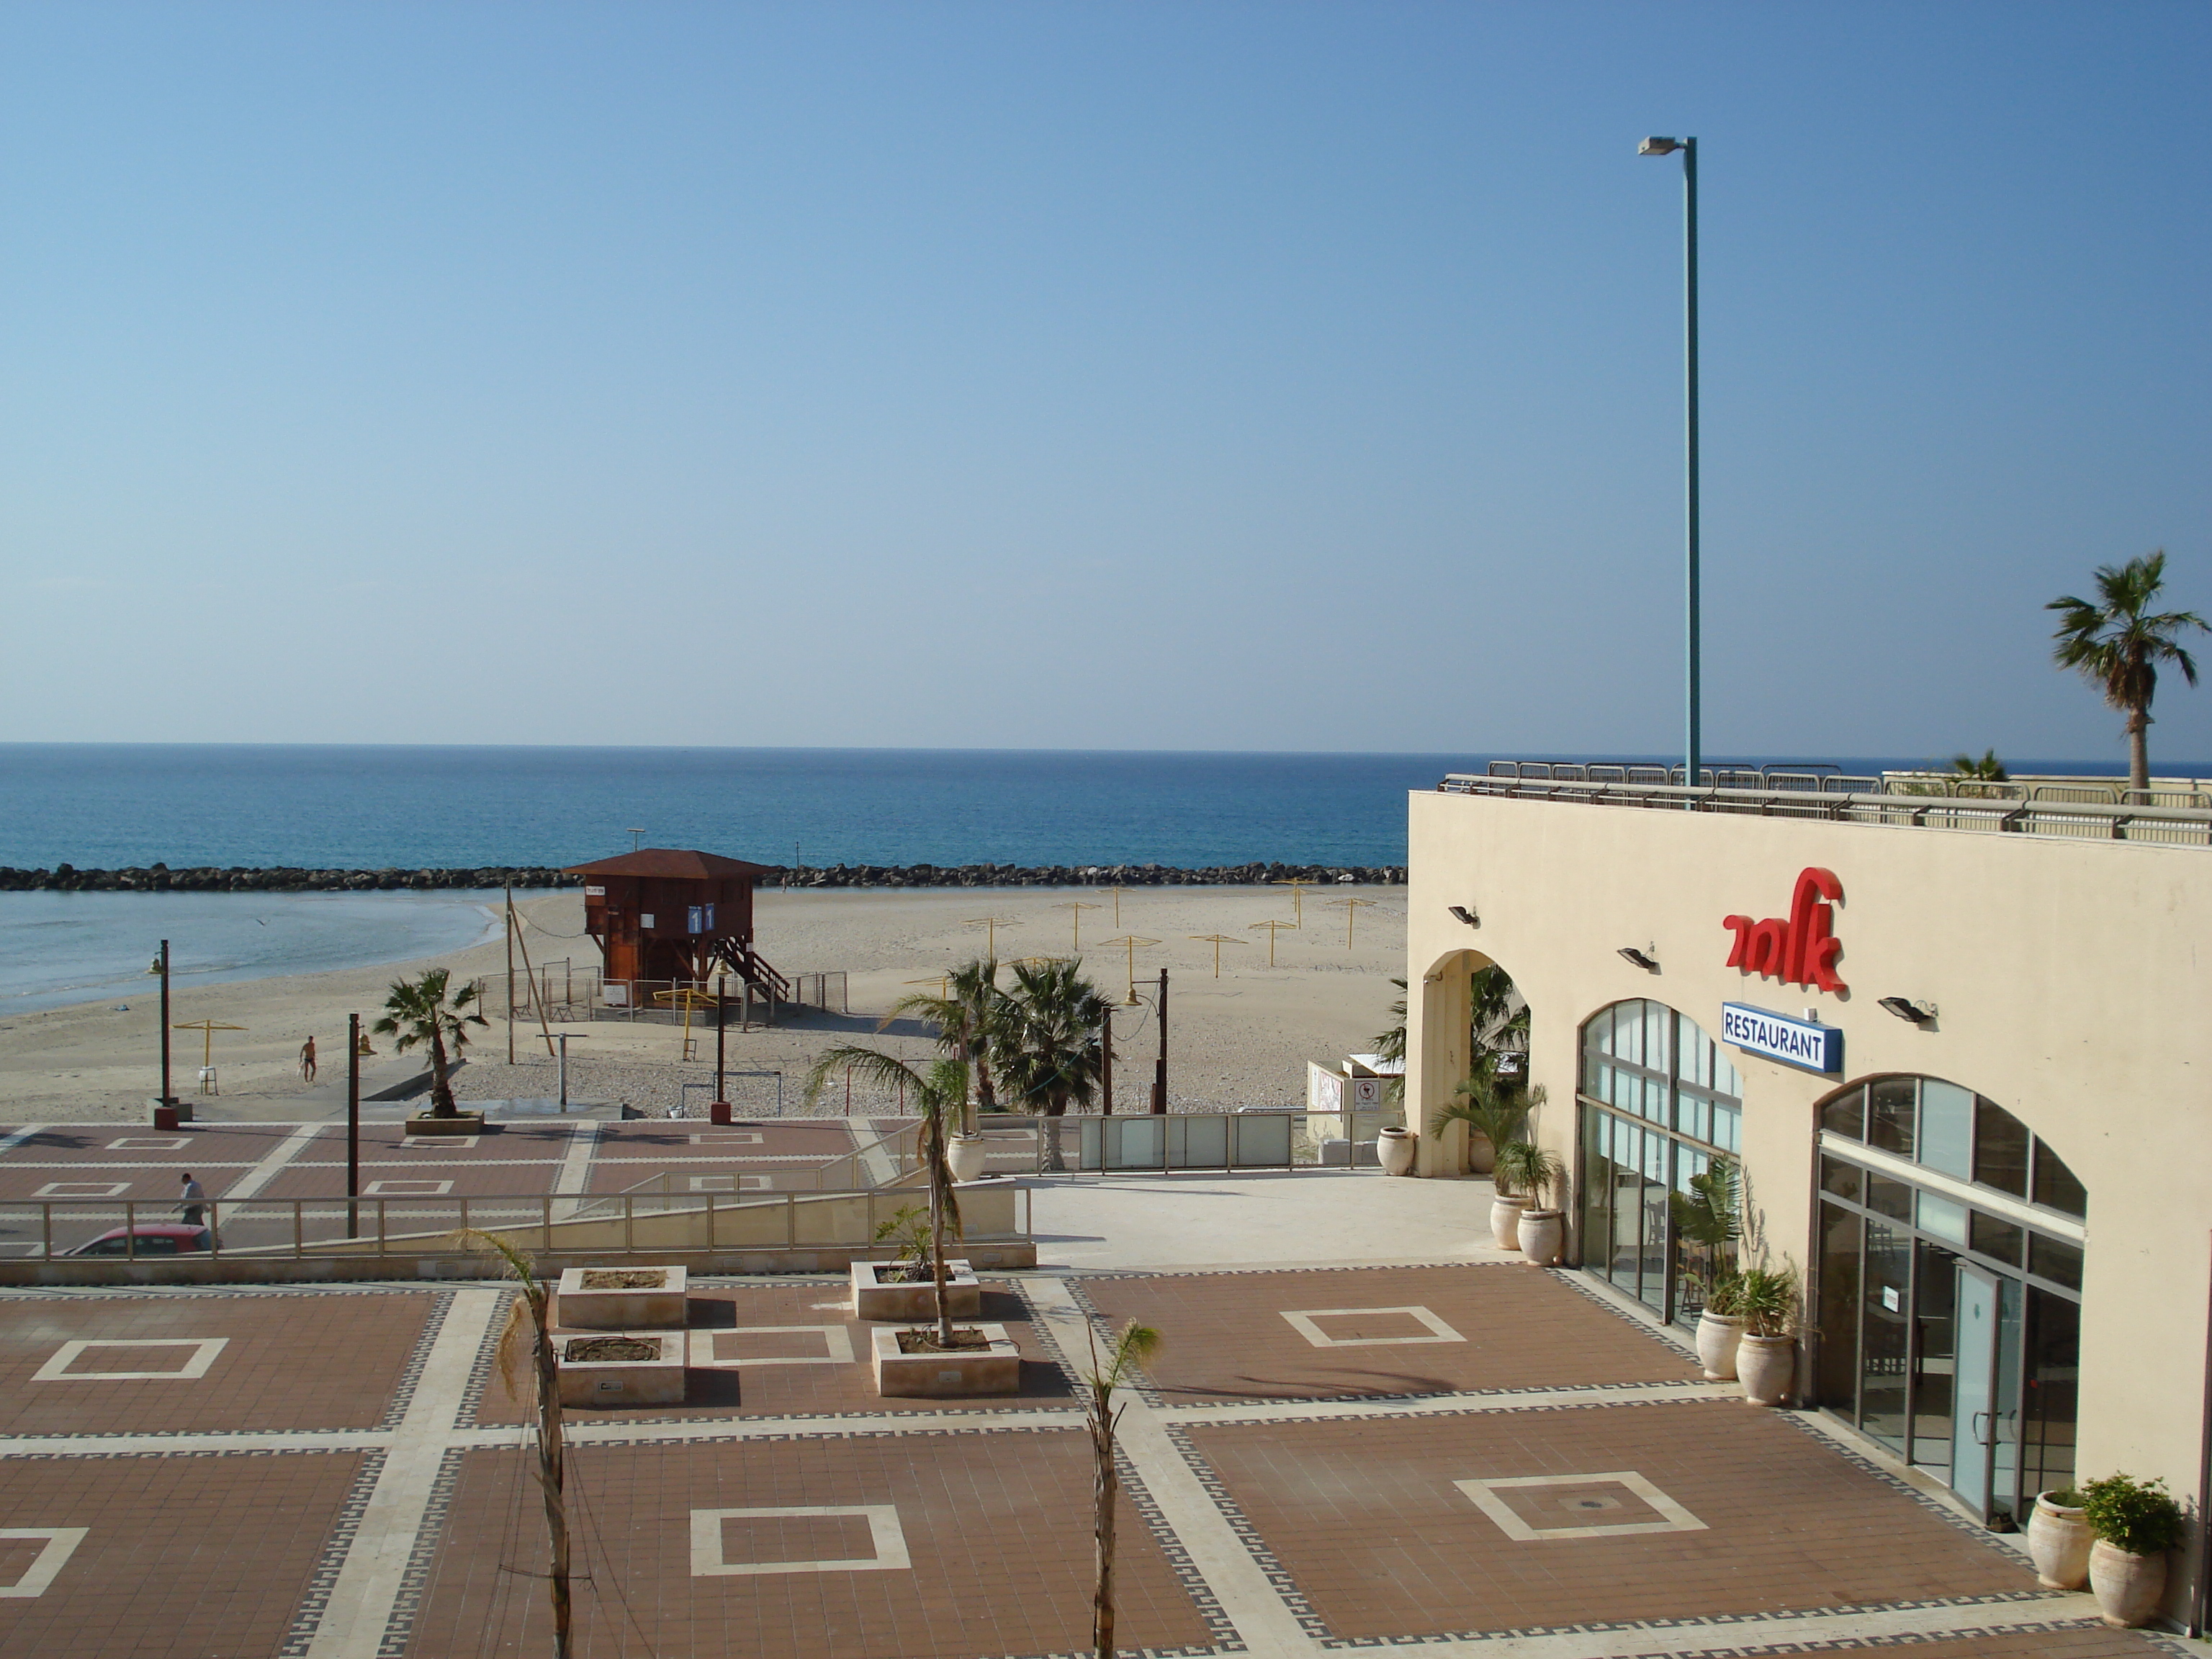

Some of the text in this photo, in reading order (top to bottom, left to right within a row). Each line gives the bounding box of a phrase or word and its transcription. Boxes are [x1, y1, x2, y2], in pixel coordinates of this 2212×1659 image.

[692, 912, 698, 932] 1
[707, 909, 712, 929] 1
[1725, 1012, 1822, 1061] RESTAURANT
